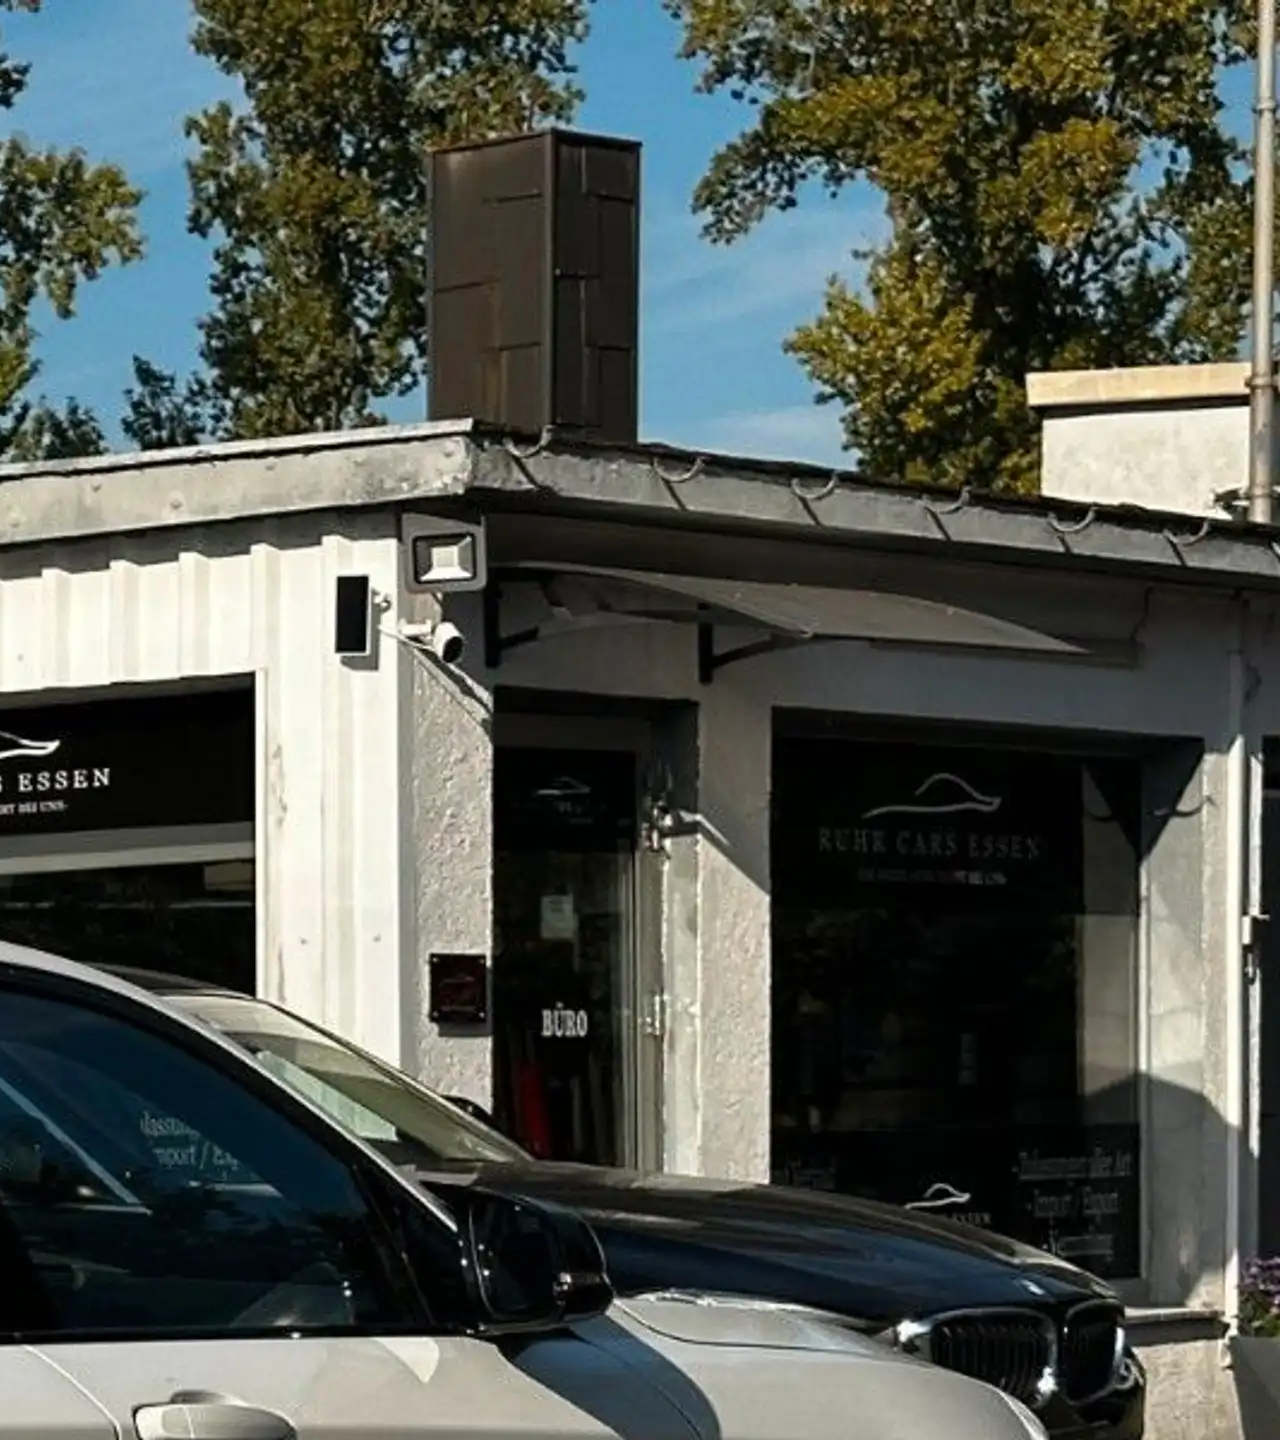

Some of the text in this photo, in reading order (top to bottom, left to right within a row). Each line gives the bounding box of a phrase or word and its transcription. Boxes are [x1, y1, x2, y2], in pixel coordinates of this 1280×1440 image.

[17, 767, 111, 793] ESSEN
[818, 825, 886, 854] RUHR
[896, 828, 958, 857] CARS
[541, 1003, 588, 1037] BÜRO
